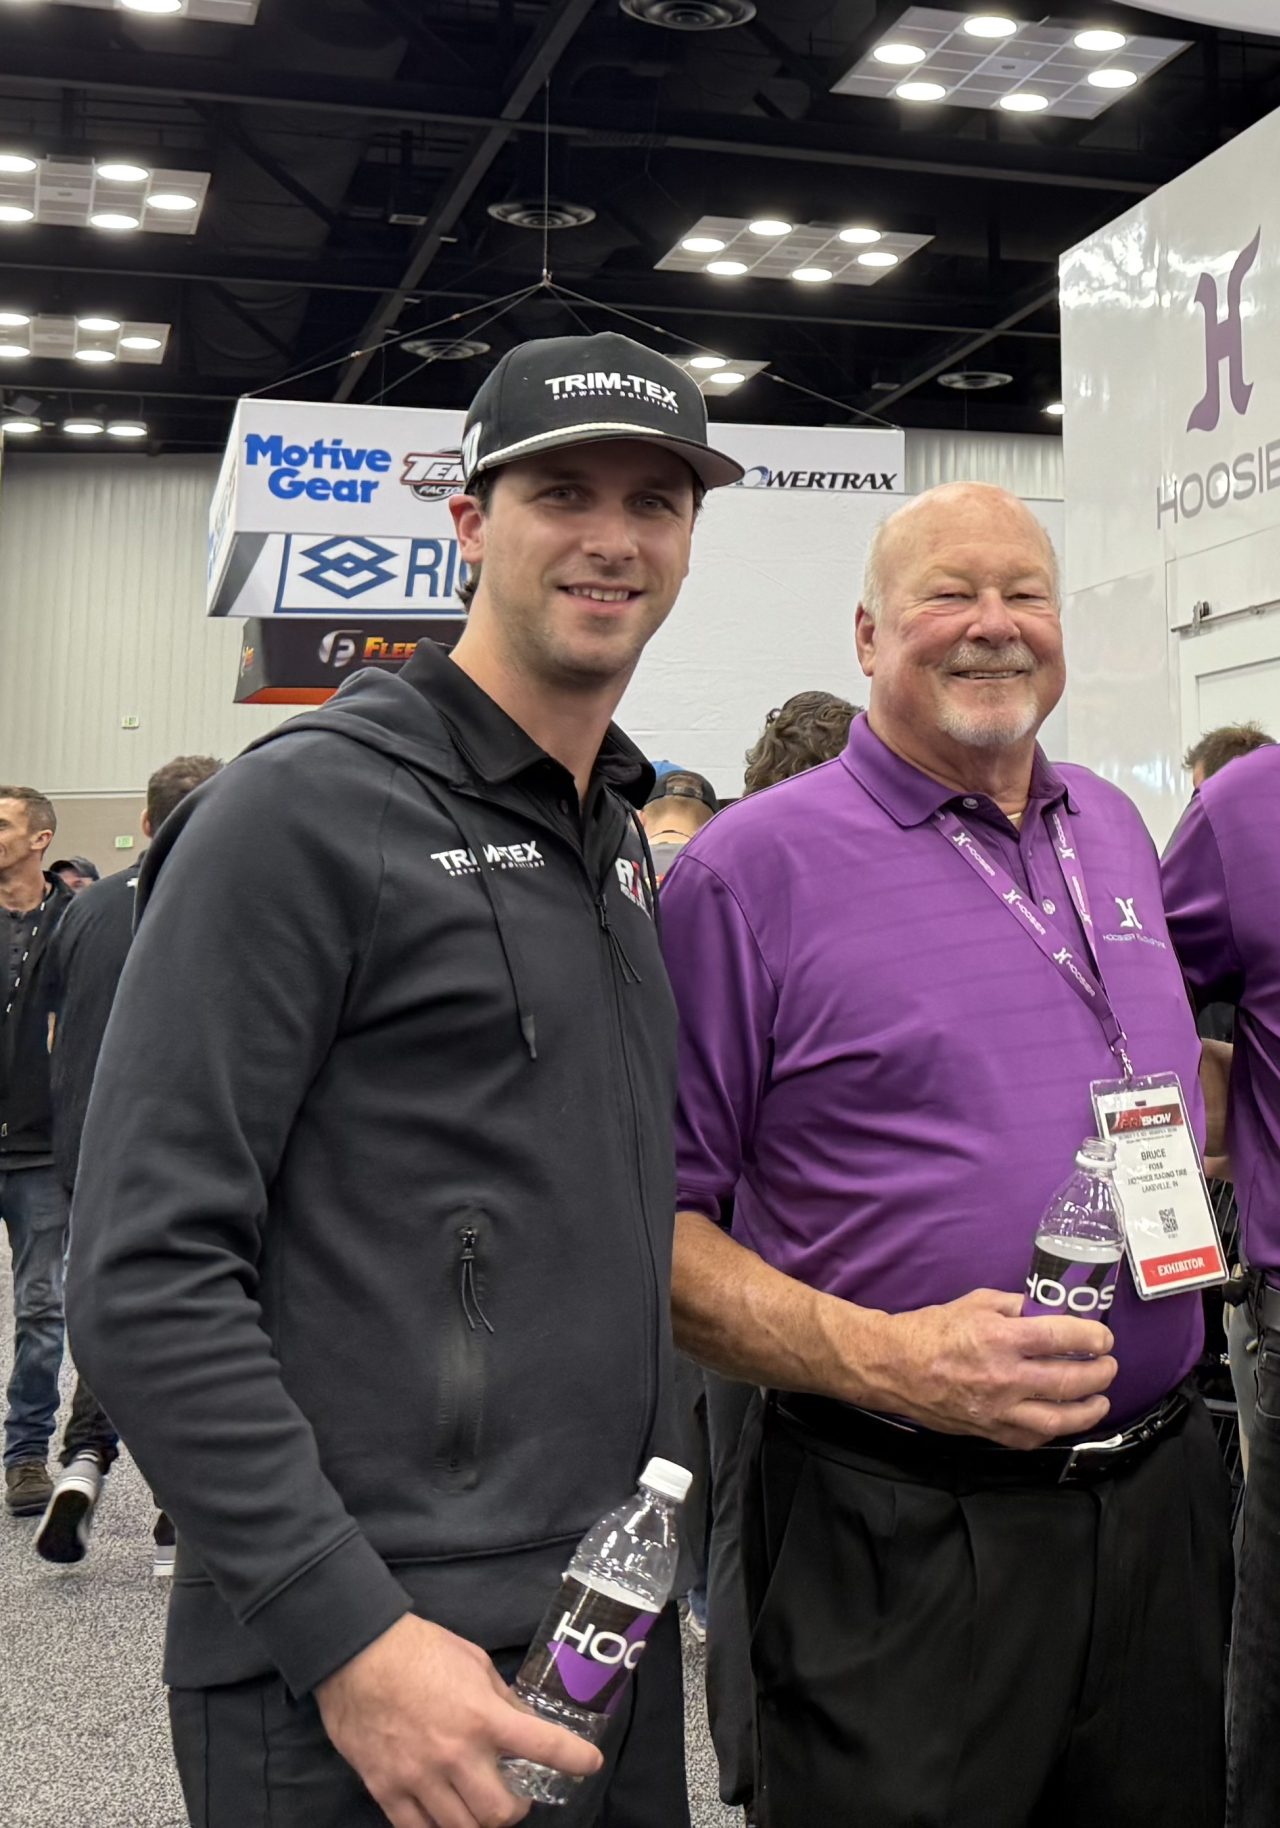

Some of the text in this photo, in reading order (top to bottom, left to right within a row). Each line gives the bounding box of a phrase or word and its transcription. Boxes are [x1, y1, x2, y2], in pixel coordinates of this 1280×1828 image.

[545, 372, 679, 408] TRIM-TEX
[554, 390, 679, 414] DRYWALL SOLUTIONS
[244, 433, 392, 472] Motive
[268, 468, 379, 503] Gear
[735, 465, 898, 491] OWERTRAX
[1141, 1148, 1166, 1161] BRUCE
[1157, 1257, 1205, 1276] EXHIBITOR
